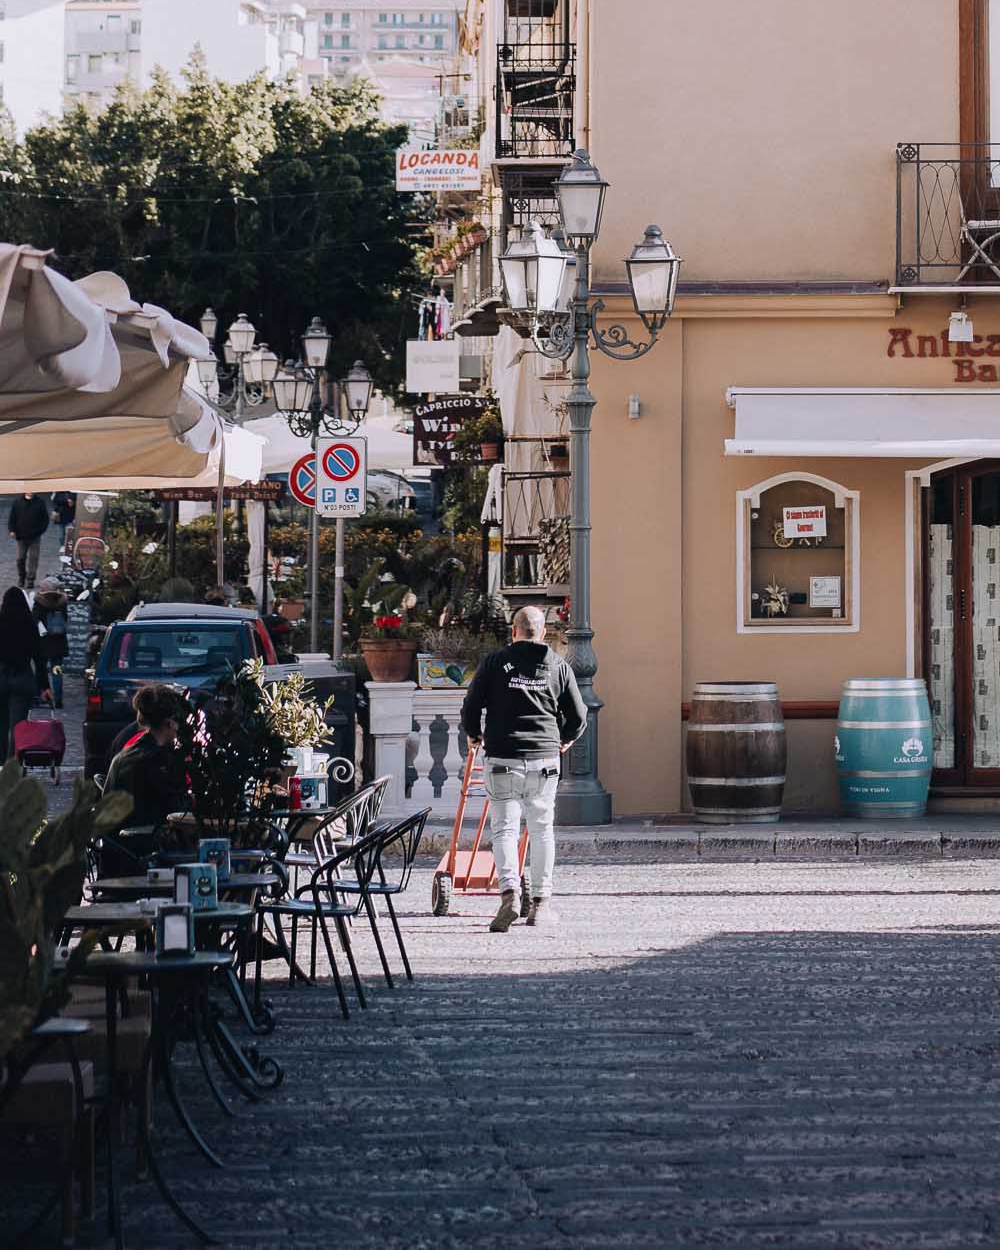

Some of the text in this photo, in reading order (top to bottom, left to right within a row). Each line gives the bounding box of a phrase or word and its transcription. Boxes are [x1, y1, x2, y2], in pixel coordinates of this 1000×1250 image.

[400, 152, 479, 171] LOCANDA
[415, 398, 471, 416] CAPRICCIO
[324, 489, 333, 501] P
